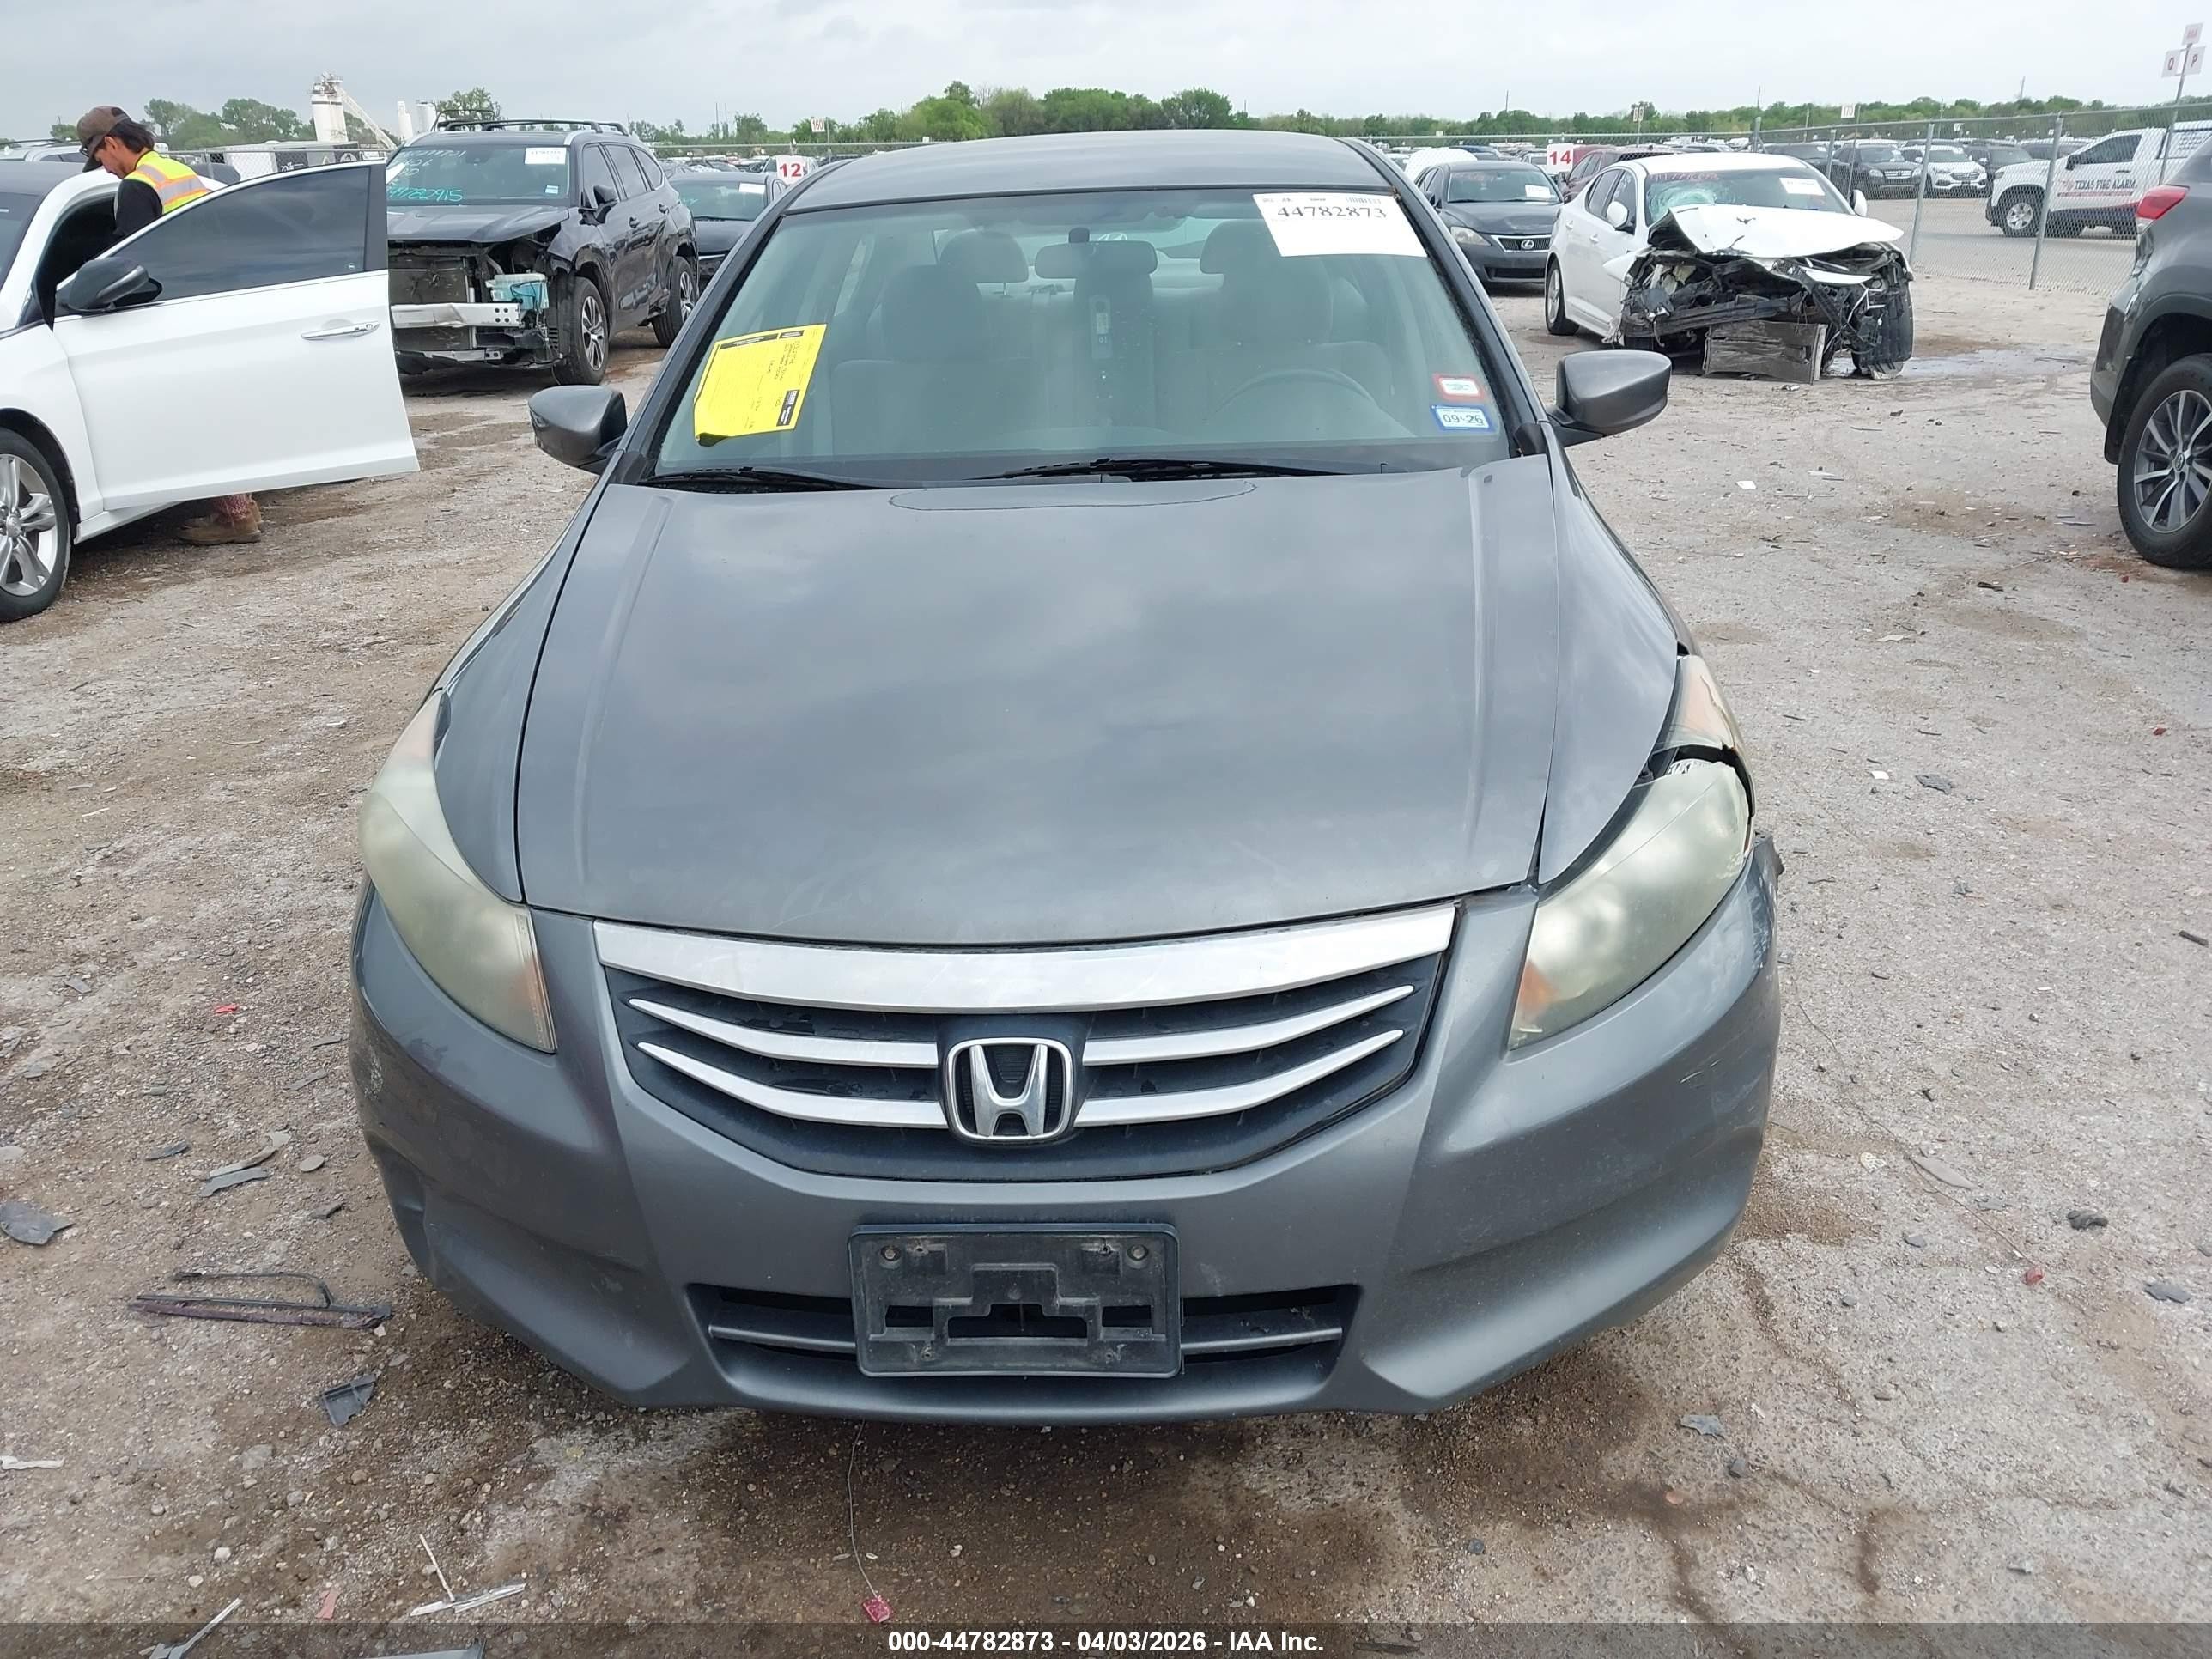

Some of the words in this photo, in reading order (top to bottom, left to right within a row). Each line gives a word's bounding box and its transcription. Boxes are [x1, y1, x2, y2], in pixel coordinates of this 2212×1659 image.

[812, 118, 823, 131] 160
[1549, 150, 1571, 166] 14
[779, 163, 802, 178] 12
[2075, 180, 2094, 190] TEXAS
[2095, 179, 2111, 189] FIRE
[2112, 179, 2136, 189] ALARM
[1277, 206, 1387, 218] 44782873
[1443, 414, 1460, 423] 09
